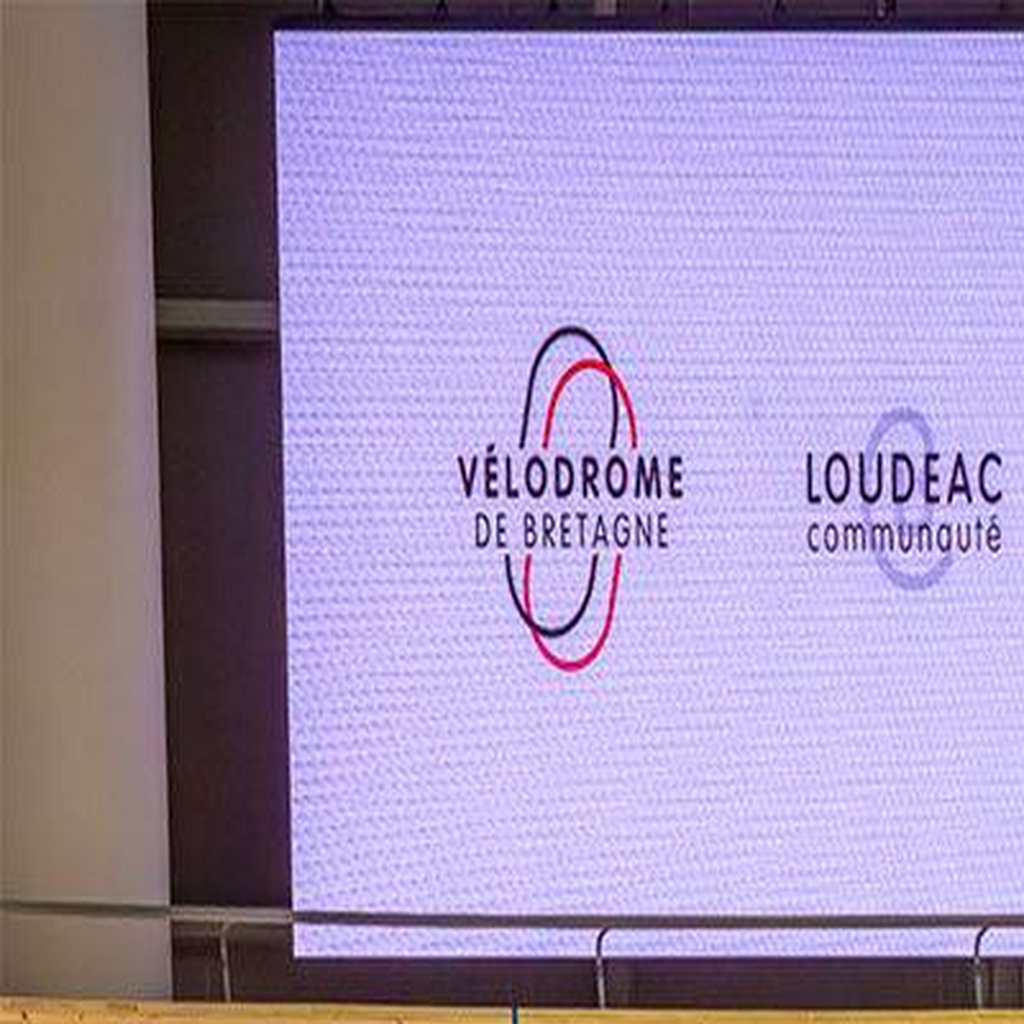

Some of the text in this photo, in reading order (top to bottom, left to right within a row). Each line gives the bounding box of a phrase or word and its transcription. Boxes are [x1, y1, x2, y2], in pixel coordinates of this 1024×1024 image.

[457, 443, 683, 498] VÉLODROME
[806, 451, 1003, 504] LOUDEAC
[475, 512, 668, 548] DE BRETAGNE
[807, 514, 1002, 553] communauté
